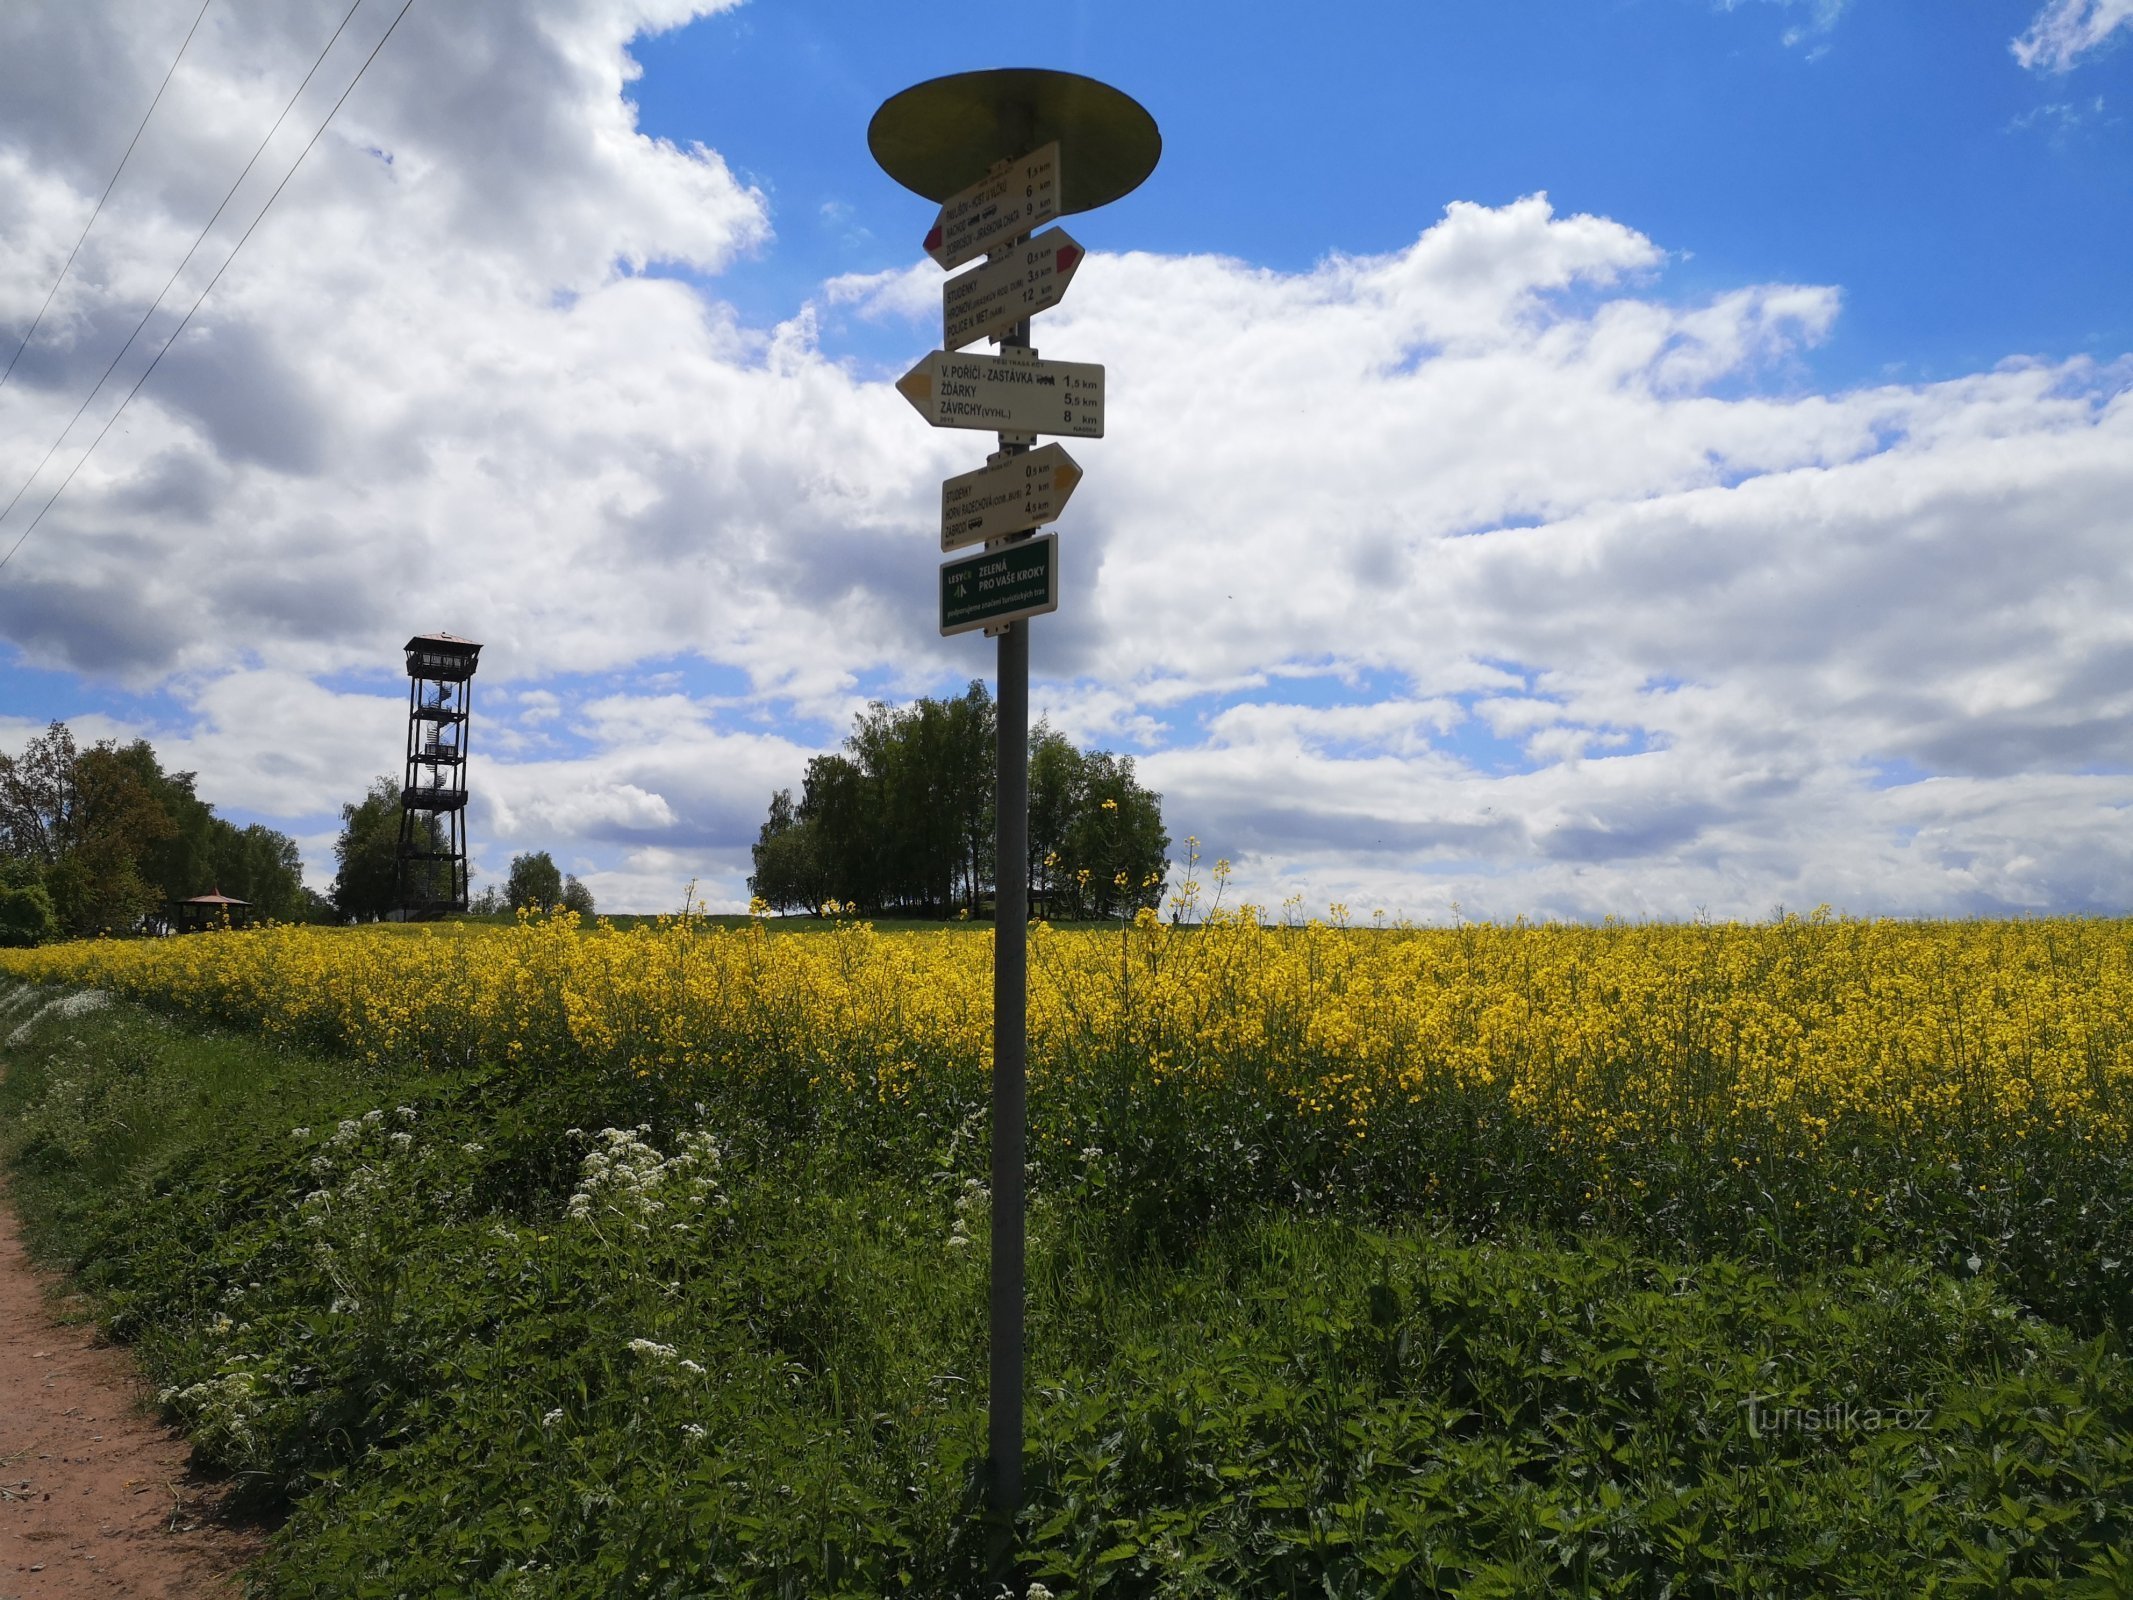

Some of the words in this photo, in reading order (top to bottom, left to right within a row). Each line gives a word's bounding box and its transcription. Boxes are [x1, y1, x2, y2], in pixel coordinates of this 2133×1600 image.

[1039, 163, 1050, 172] km
[1026, 185, 1032, 198] 6
[1040, 180, 1050, 190] km
[1026, 203, 1032, 216] 9
[1040, 199, 1050, 208] km
[1027, 250, 1038, 265] 0,5
[1040, 248, 1051, 258] km
[1028, 269, 1038, 282] 3,5
[1040, 266, 1051, 277] km
[1022, 288, 1034, 302] 12
[1041, 285, 1052, 294] km
[941, 364, 949, 378] V.
[951, 364, 981, 380] POŘÍČÍ
[987, 368, 1033, 384] ZASTÁVKA
[1063, 374, 1080, 388] 1,5
[1082, 380, 1097, 389] km
[941, 381, 977, 398] ŽĎÁRKY
[1064, 392, 1080, 407] 5,5
[1082, 397, 1098, 407] km
[1063, 410, 1072, 423] 8
[1082, 415, 1097, 425] km
[1038, 463, 1049, 472] km
[1026, 483, 1031, 496] 2
[1038, 482, 1049, 491] km
[1025, 501, 1036, 513] 4,5
[978, 558, 1007, 577] ZELENÁ
[978, 579, 994, 592] PRO
[995, 572, 1015, 587] VAŠE
[1016, 566, 1045, 582] KROKY
